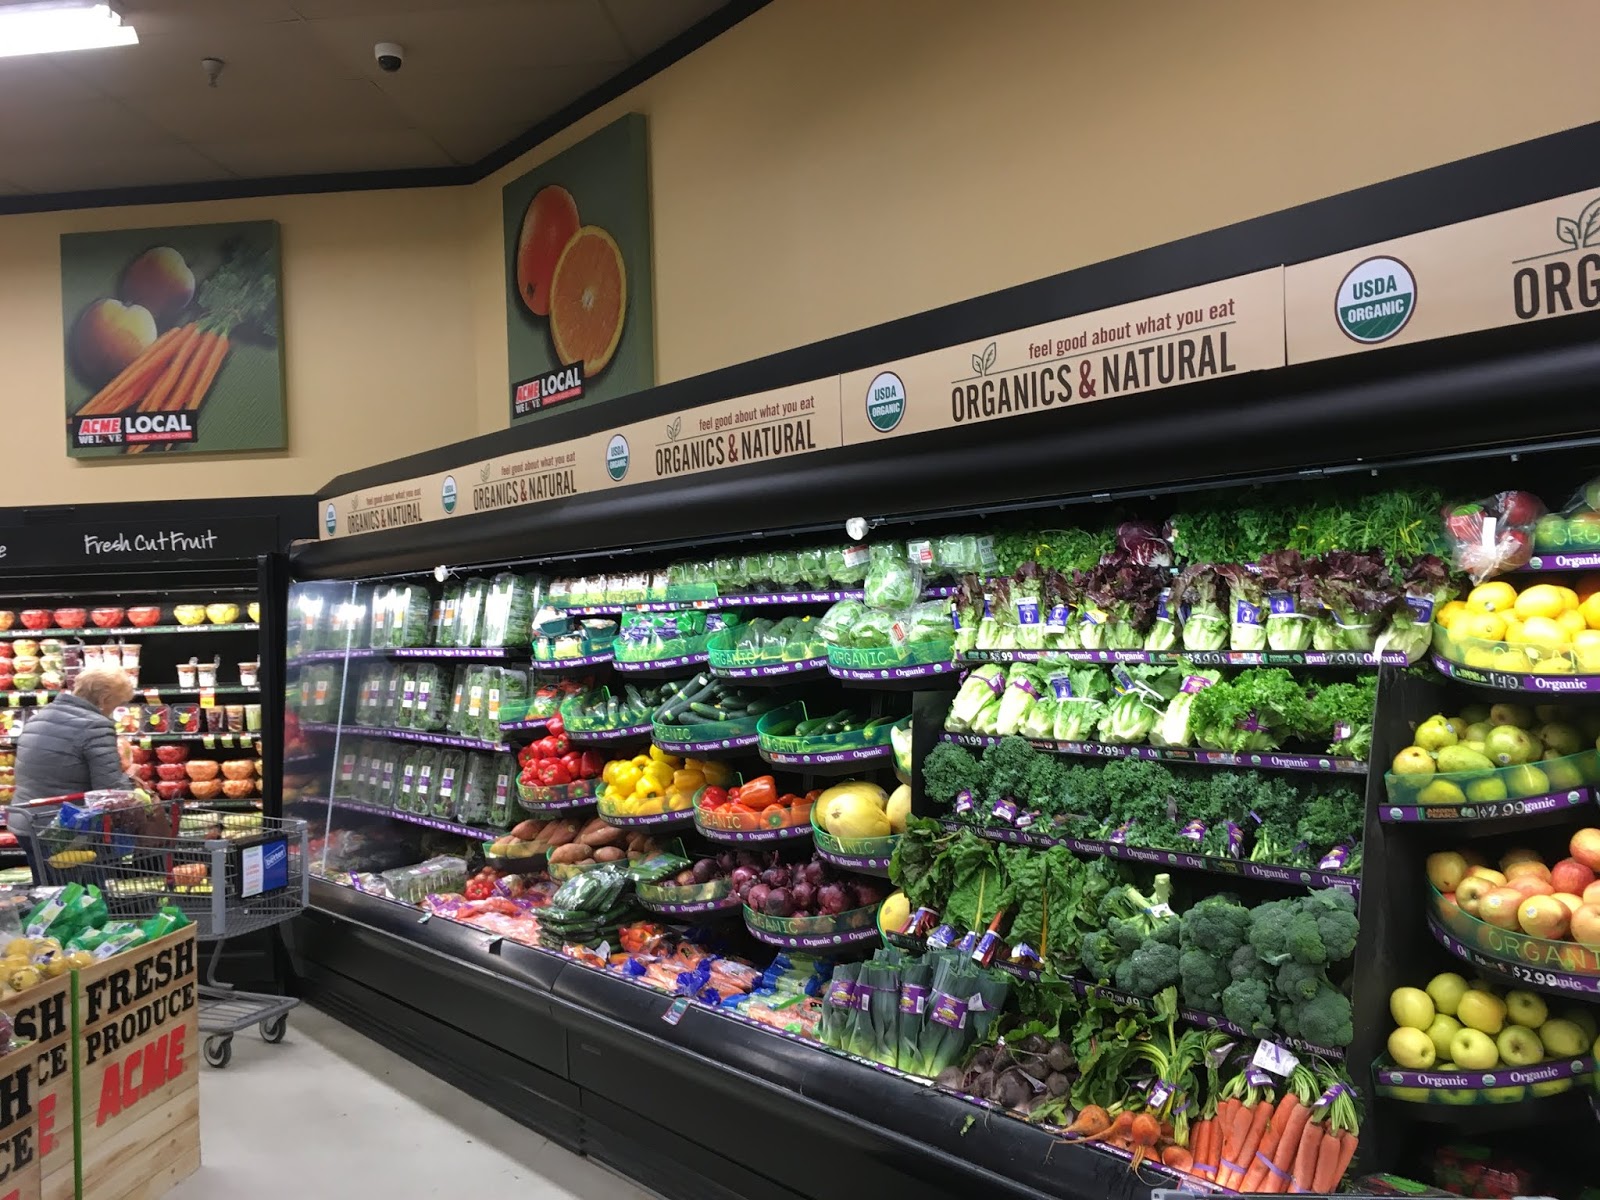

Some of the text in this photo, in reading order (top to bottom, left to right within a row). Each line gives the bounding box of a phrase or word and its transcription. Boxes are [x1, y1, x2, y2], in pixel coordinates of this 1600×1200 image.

[1353, 275, 1397, 300] USDA
[1348, 299, 1404, 323] ORGANIC
[1029, 299, 1235, 360] feel good about what you eat
[541, 367, 582, 397] LOCAL
[951, 331, 1237, 422] ORGANICS & NATURAL
[516, 380, 540, 404] ACME
[874, 385, 896, 401] USDA
[525, 398, 540, 411] LVE
[872, 402, 900, 418] ORGANIC
[699, 395, 815, 431] feel good about what you eat
[80, 418, 121, 434] ACME
[125, 414, 192, 433] LOCAL
[79, 435, 94, 444] WE
[95, 434, 122, 444] LVE
[611, 444, 624, 456] USDA
[656, 419, 816, 476] ORGANICS & NATURAL
[473, 470, 577, 511] ORGANICS & NATURAL
[347, 510, 379, 534] ORGANICS
[387, 502, 422, 526] NATURAL
[84, 529, 218, 554] Fresh Cut Fruit
[811, 593, 829, 601] Organic
[654, 659, 677, 668] Organic
[1115, 651, 1145, 661] Organic
[1363, 652, 1404, 664] Oranic
[763, 664, 789, 675] Organic
[852, 670, 875, 679] Organic
[896, 666, 925, 677] Organic
[1535, 678, 1588, 691] Organic
[696, 741, 720, 750] Organic
[736, 735, 758, 744] Organi
[816, 753, 844, 762] Organic
[853, 747, 882, 758] Organic
[1271, 756, 1309, 768] Organic
[1524, 798, 1556, 813] ganic
[639, 810, 694, 824] Organic Organ
[749, 832, 775, 841] Organic
[1075, 841, 1104, 853] Organic
[1127, 848, 1159, 861] Organic
[1251, 865, 1290, 880] Organic
[803, 937, 831, 946] Organic
[849, 928, 878, 940] Organic
[85, 937, 195, 1025] FRESH
[1513, 966, 1557, 986] $2.99
[86, 981, 194, 1065] PRODUCE
[96, 1024, 186, 1128] ACME
[1418, 1067, 1559, 1087] Organic Organic
